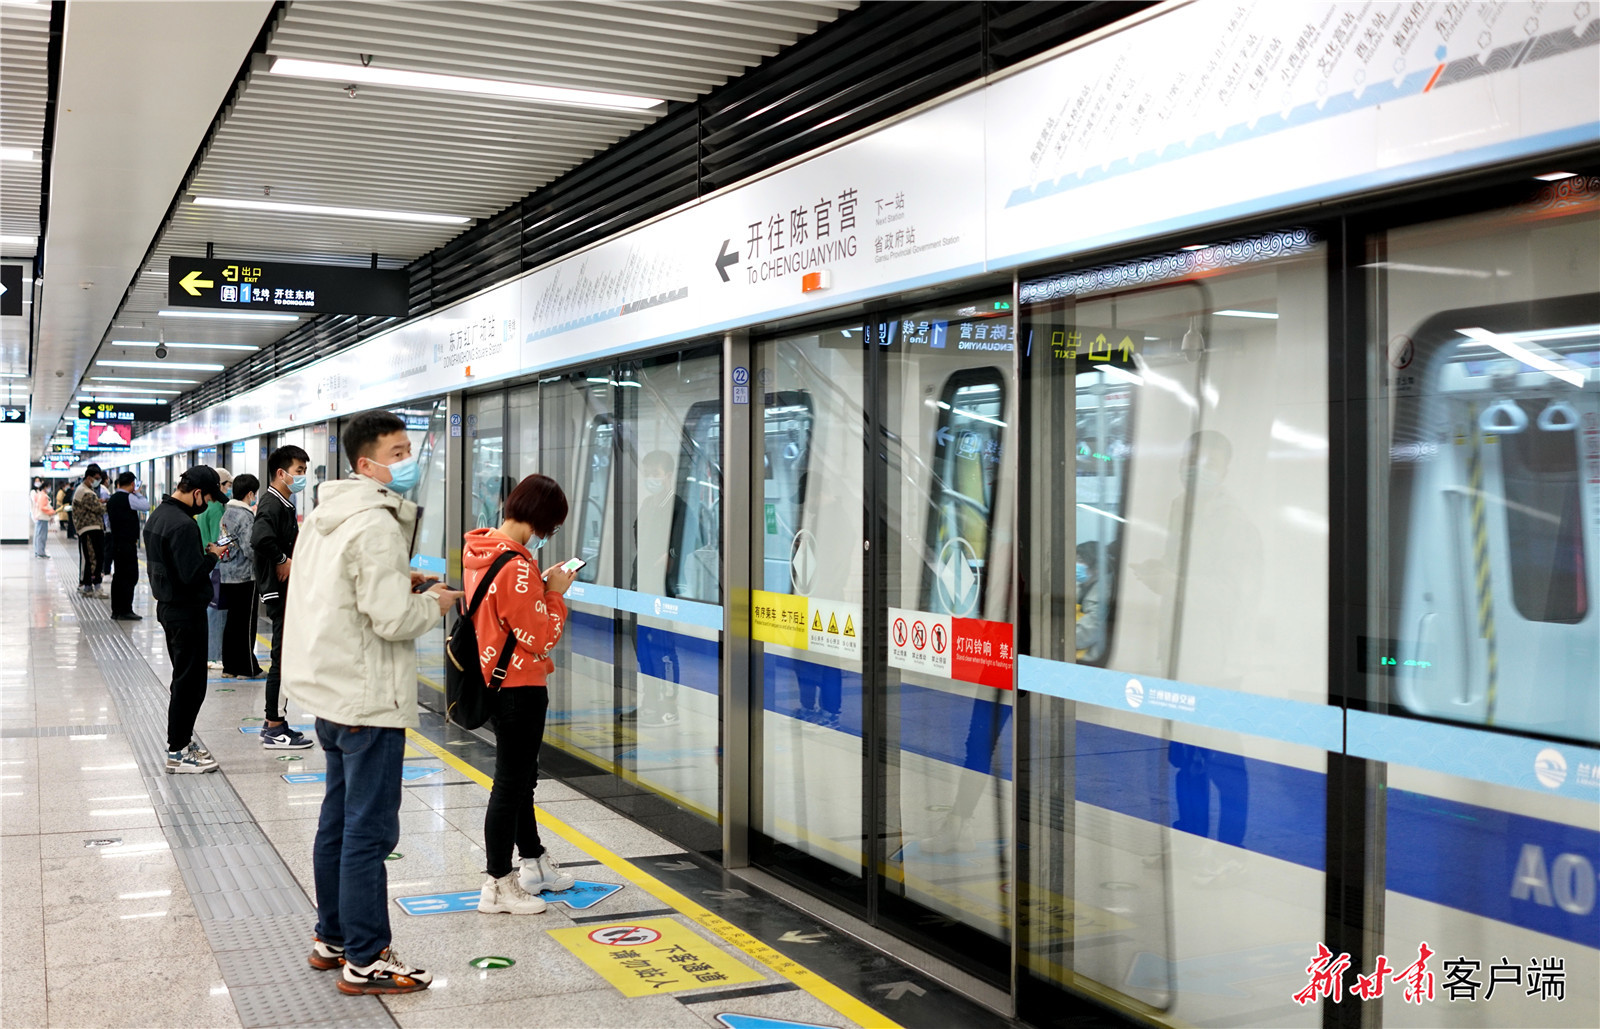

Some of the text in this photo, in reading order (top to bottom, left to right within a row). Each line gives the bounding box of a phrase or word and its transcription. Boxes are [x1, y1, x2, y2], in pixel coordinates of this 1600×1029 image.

[1390, 0, 1426, 48] 省政府
[1435, 0, 1460, 35] 东方
[1316, 10, 1355, 71] 文化宫站
[1353, 10, 1386, 58] 西关站
[1278, 21, 1317, 81] 小西湖站
[874, 192, 905, 217] 下一站
[875, 211, 905, 226] Next Station
[747, 188, 858, 260] 开往陈官营
[874, 226, 917, 254] 省政府站
[942, 235, 960, 249] Station
[241, 266, 262, 277] 出口
[747, 235, 858, 285] To CHENGUANYING
[242, 286, 315, 301] 1 号线 开往东岗
[735, 369, 746, 382] 22
[755, 606, 805, 625] 有序乘车 先下后上
[956, 636, 992, 657] 灯闪铃响
[608, 949, 679, 988] 请勿站人
[655, 944, 729, 983] 下客通道
